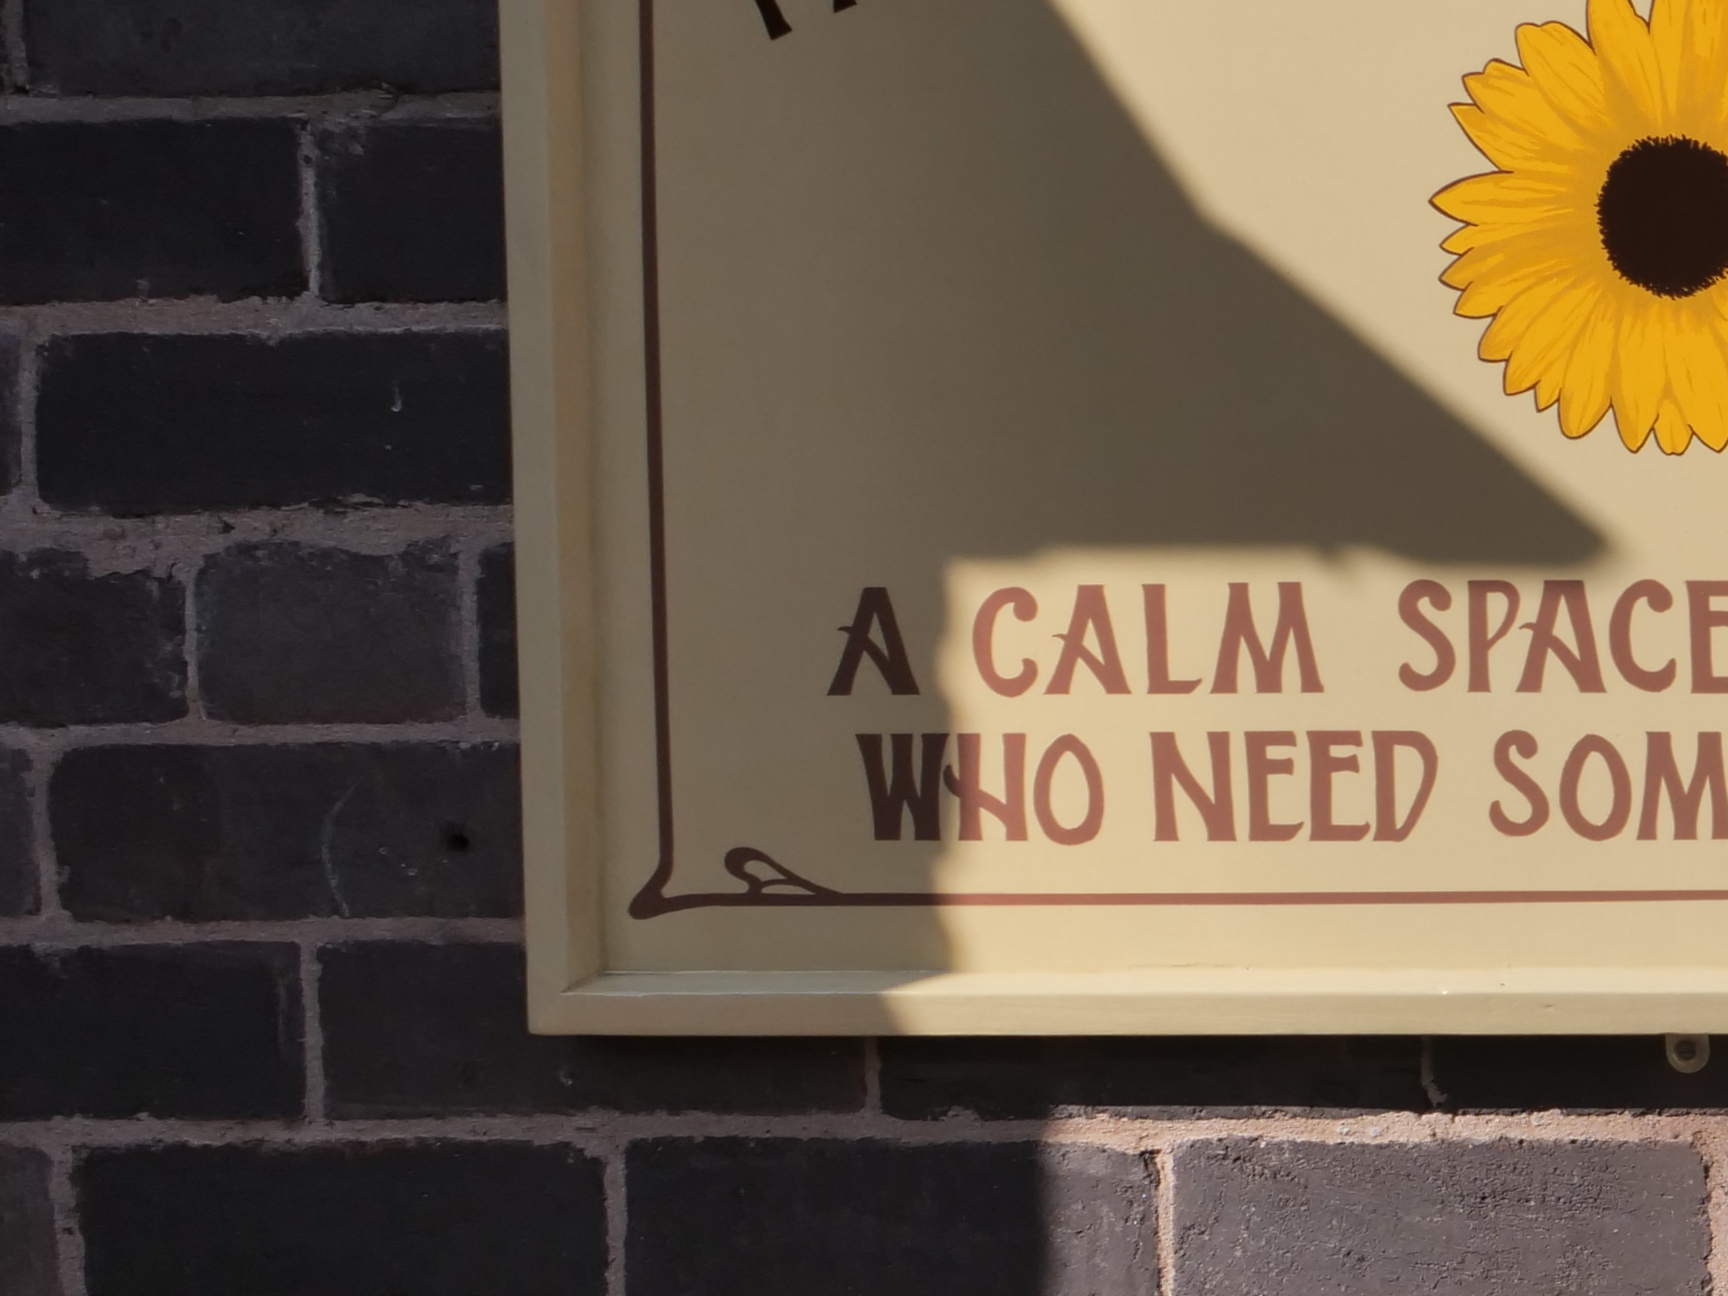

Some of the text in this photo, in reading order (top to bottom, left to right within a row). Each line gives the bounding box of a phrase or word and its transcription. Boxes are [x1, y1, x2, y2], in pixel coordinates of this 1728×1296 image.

[827, 586, 921, 696] A
[971, 581, 1325, 698] CALM
[855, 732, 1105, 846] WHO
[1148, 730, 1440, 842] NEED
